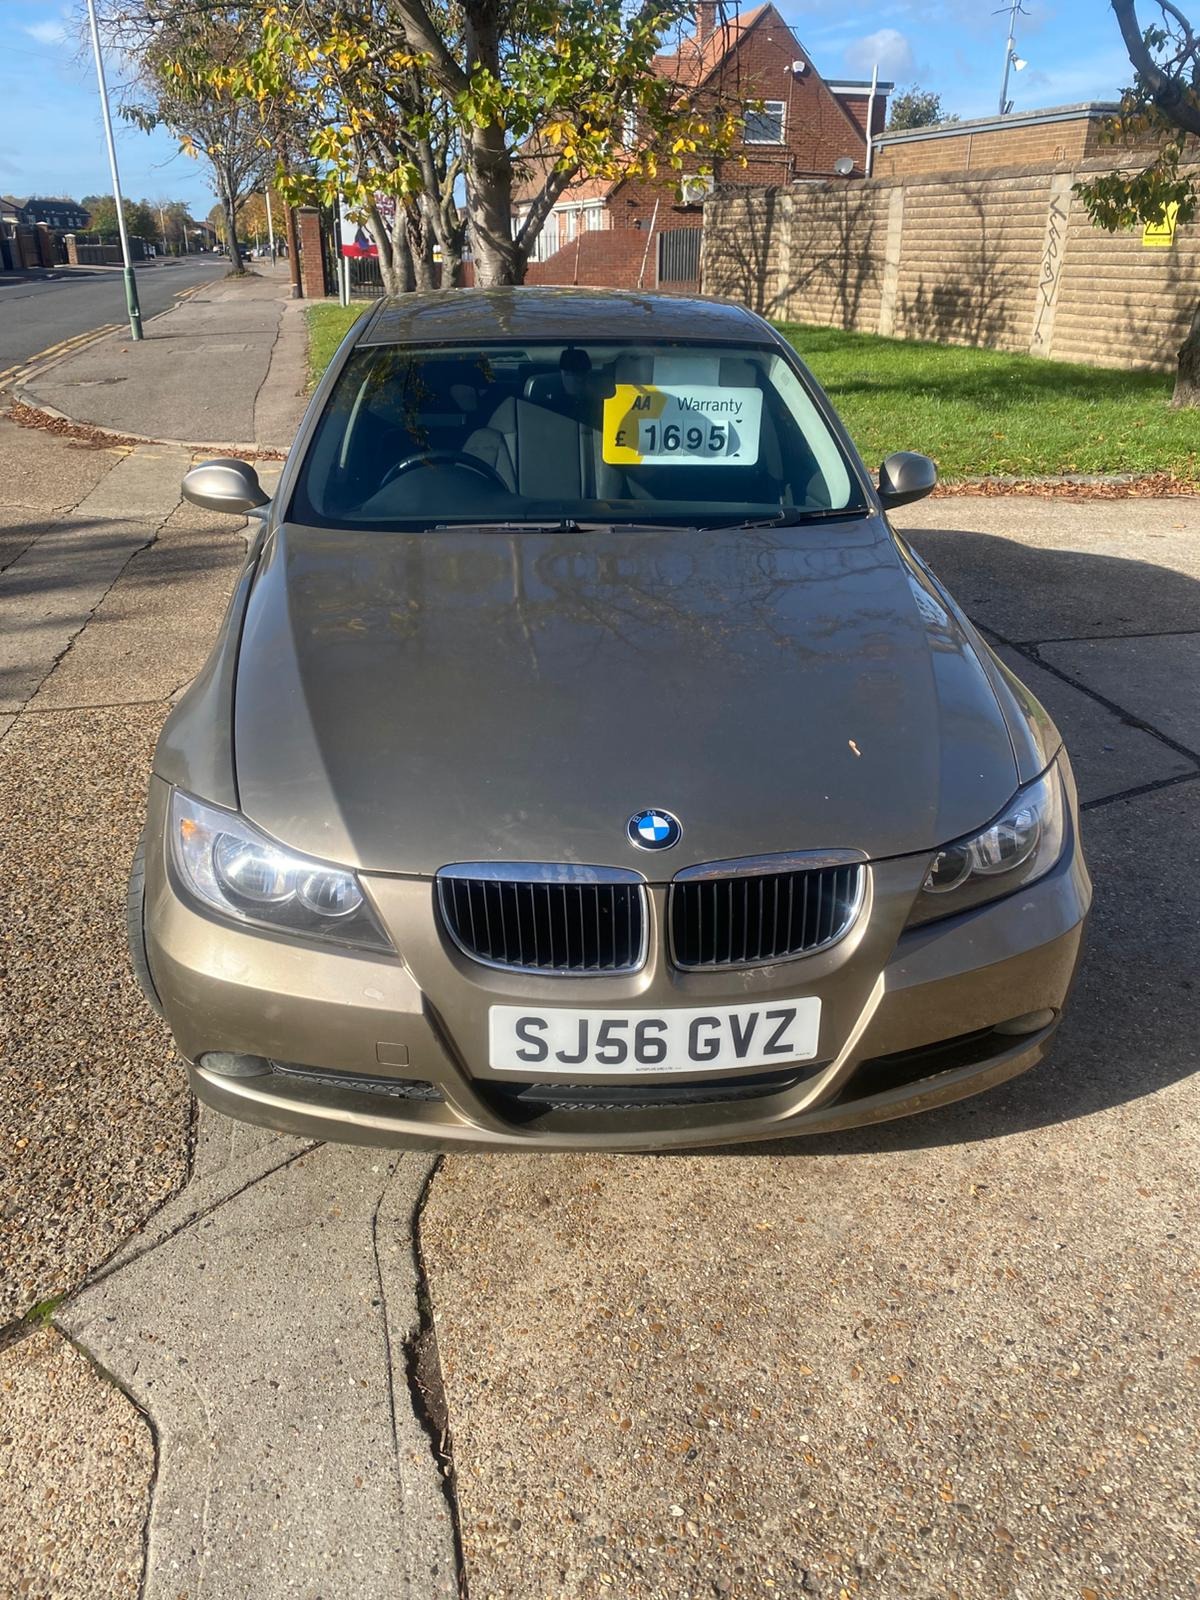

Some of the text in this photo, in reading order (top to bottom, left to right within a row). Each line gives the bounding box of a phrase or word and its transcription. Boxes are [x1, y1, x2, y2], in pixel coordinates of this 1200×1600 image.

[631, 395, 743, 414] AA Warranty
[644, 424, 727, 451] 1695
[632, 810, 673, 824] BMW
[515, 1007, 797, 1065] SJ56 GVZ
